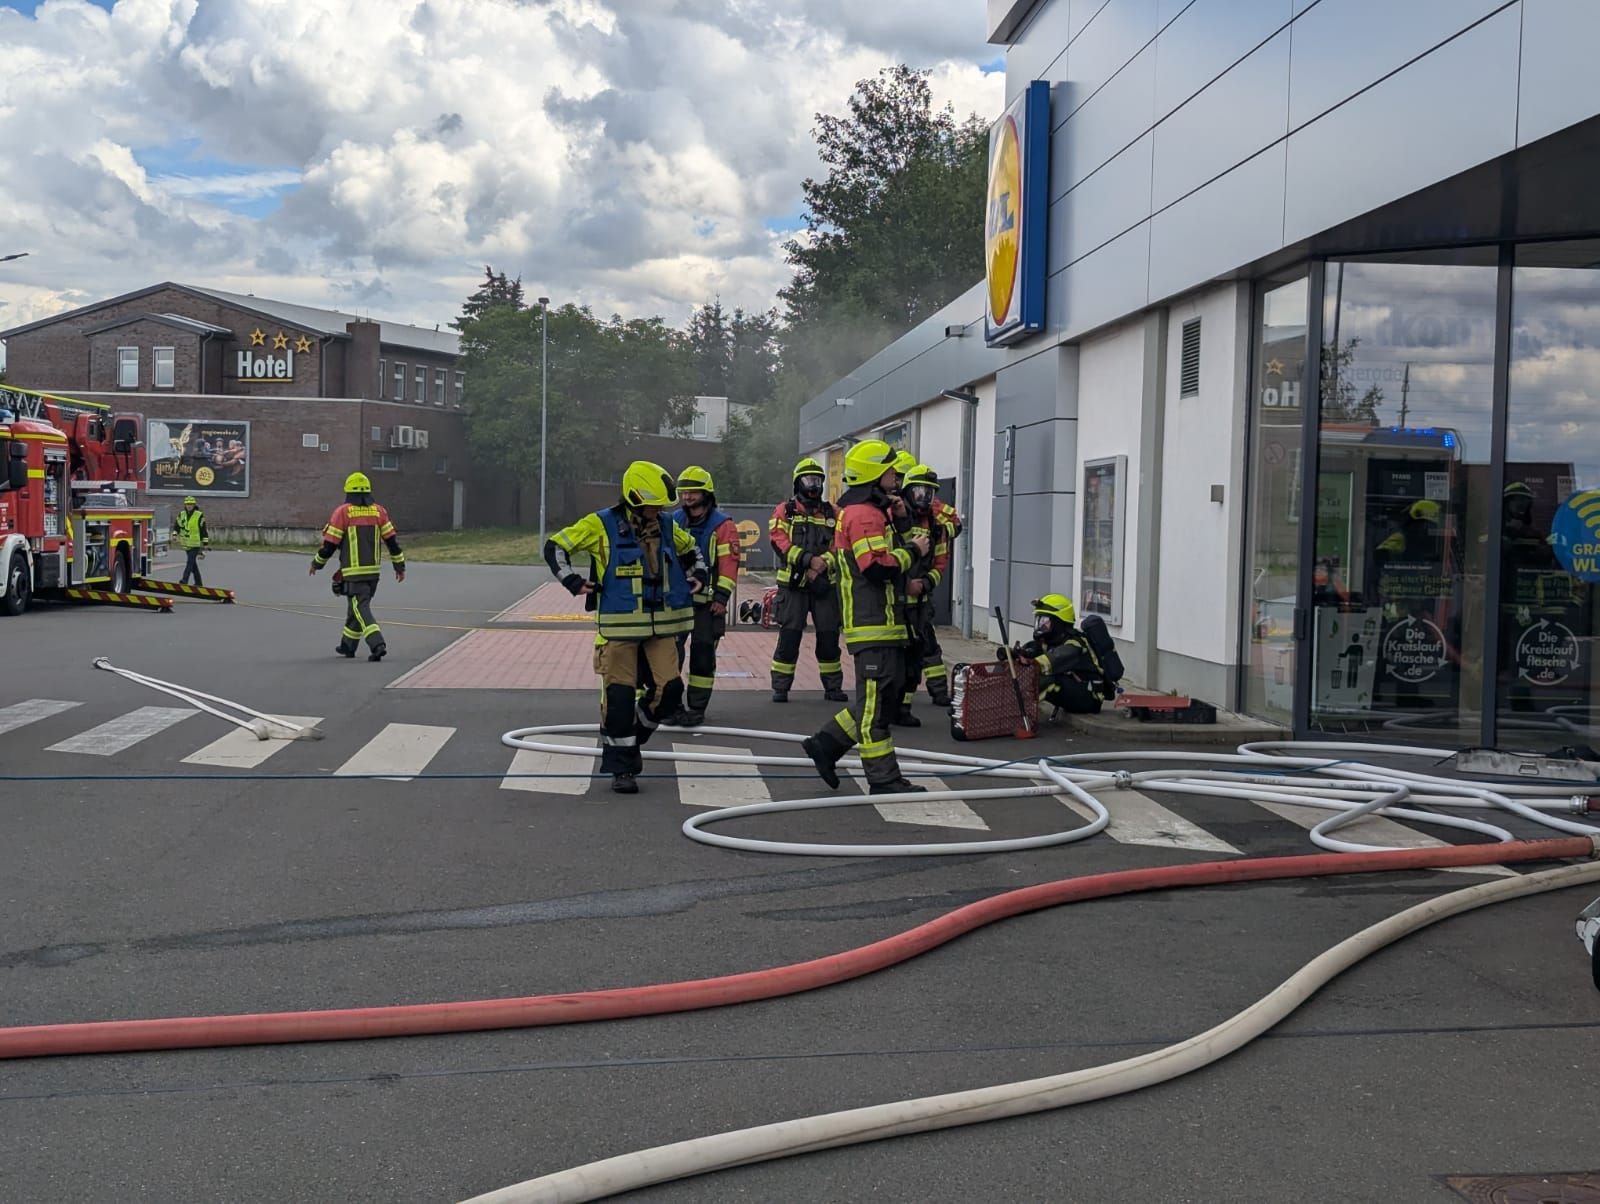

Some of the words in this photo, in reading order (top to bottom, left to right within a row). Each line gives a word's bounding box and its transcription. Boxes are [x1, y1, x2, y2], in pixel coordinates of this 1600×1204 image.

[237, 349, 293, 378] Hotel
[1405, 629, 1425, 640] Die
[1538, 632, 1558, 643] Die
[1388, 640, 1442, 651] Kreislauf
[1521, 643, 1574, 655] Kreislauf
[1394, 653, 1434, 664] flasche
[1526, 655, 1567, 667] flasche
[1404, 665, 1422, 676] .de
[1536, 669, 1555, 680] .de
